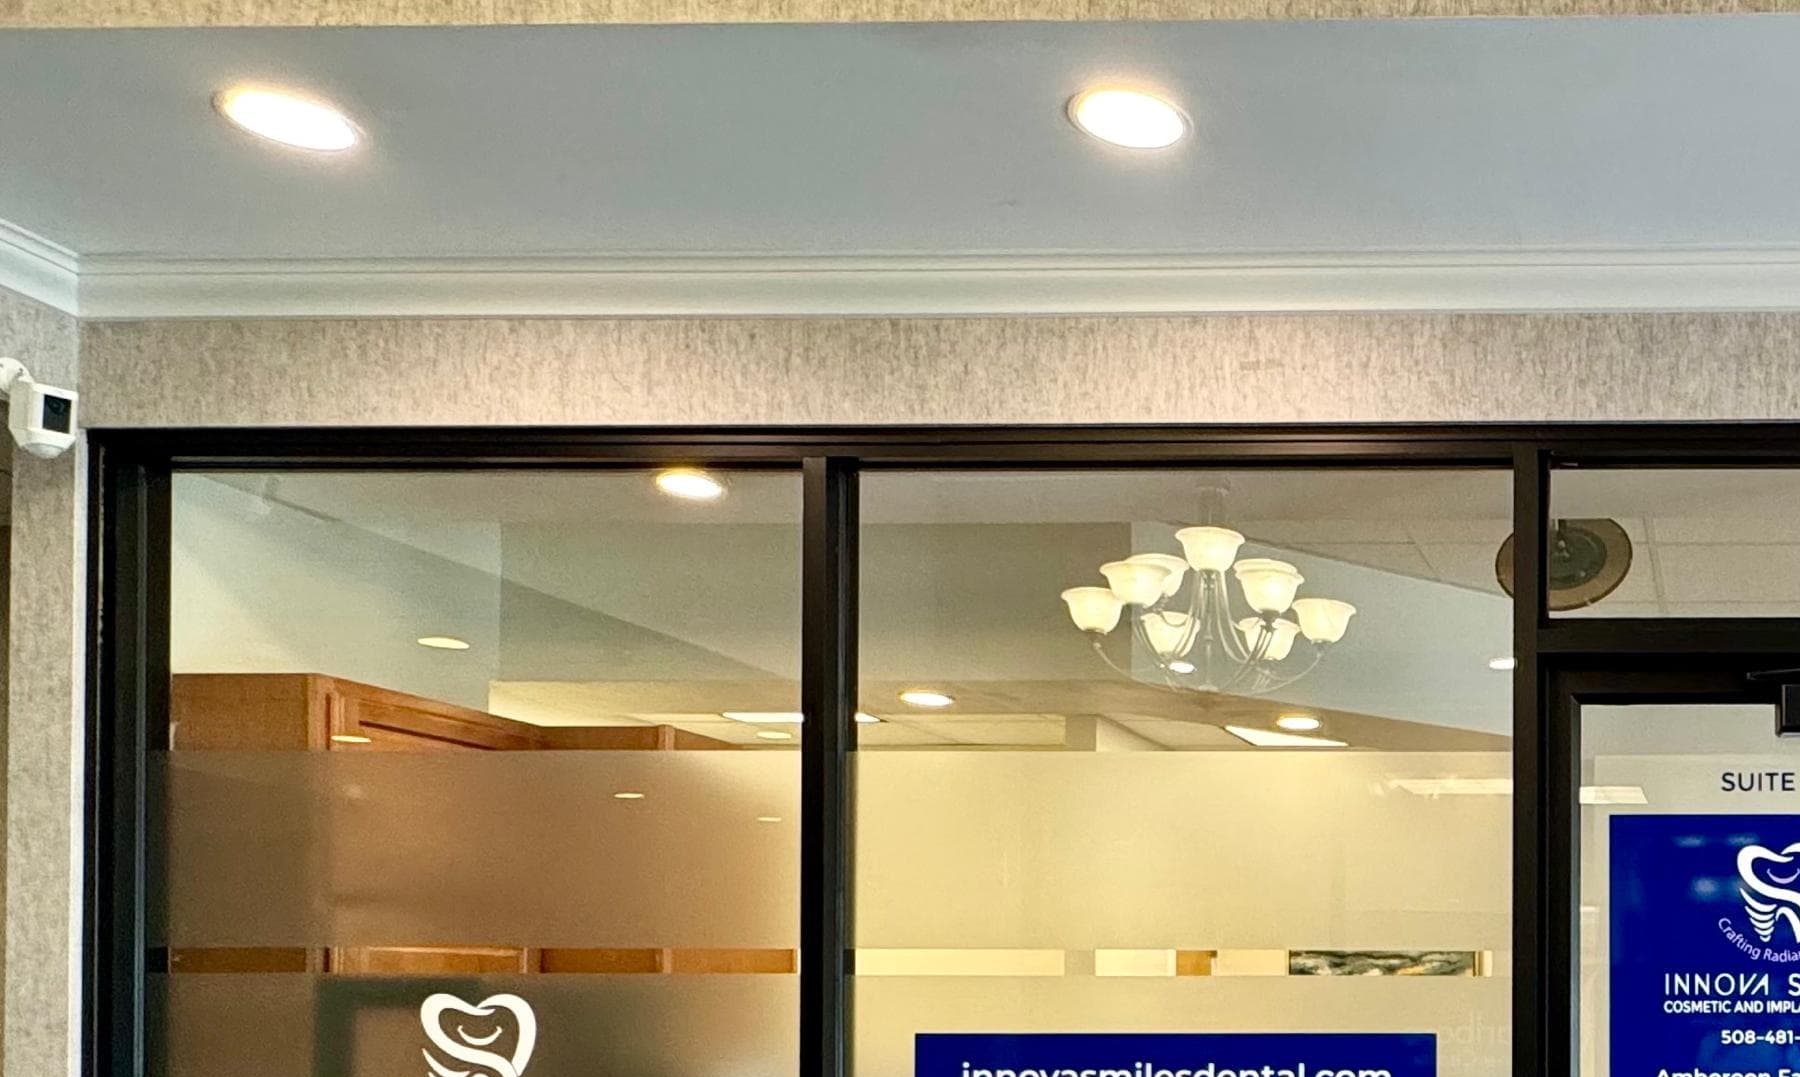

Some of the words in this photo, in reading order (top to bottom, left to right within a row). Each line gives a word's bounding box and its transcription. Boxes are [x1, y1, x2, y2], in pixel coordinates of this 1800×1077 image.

[1721, 771, 1796, 792] SUITE
[1718, 917, 1761, 960] Crafting
[1664, 972, 1769, 996] INNOVA
[1663, 1000, 1732, 1014] COSMETIC
[1734, 1000, 1764, 1014] AND
